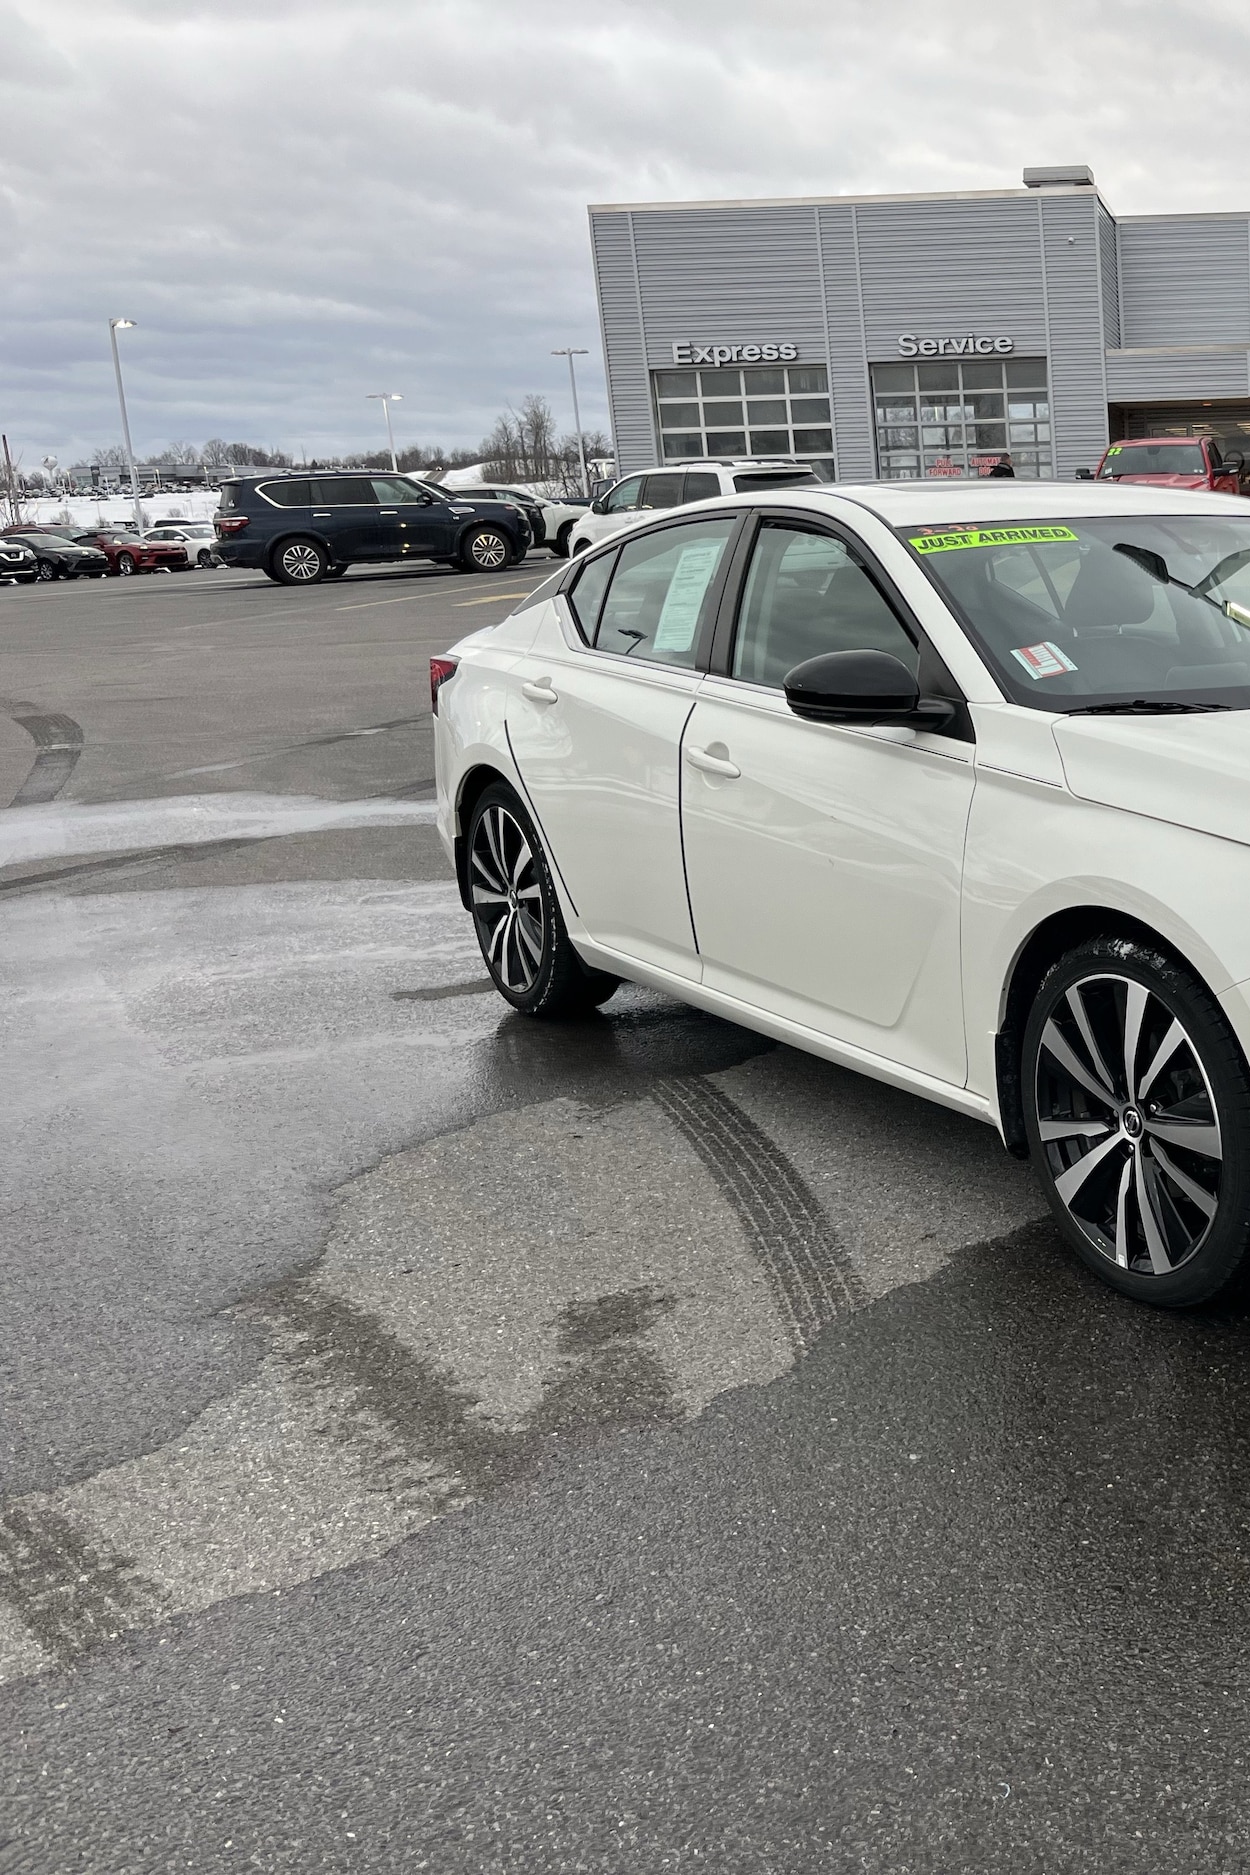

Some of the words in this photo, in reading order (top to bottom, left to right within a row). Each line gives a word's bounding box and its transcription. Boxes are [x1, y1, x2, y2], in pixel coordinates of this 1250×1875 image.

[672, 341, 798, 368] Express
[898, 333, 1013, 357] Service
[929, 468, 961, 476] FORWARD
[918, 535, 969, 550] JUST
[979, 528, 1071, 544] ARRIVED
